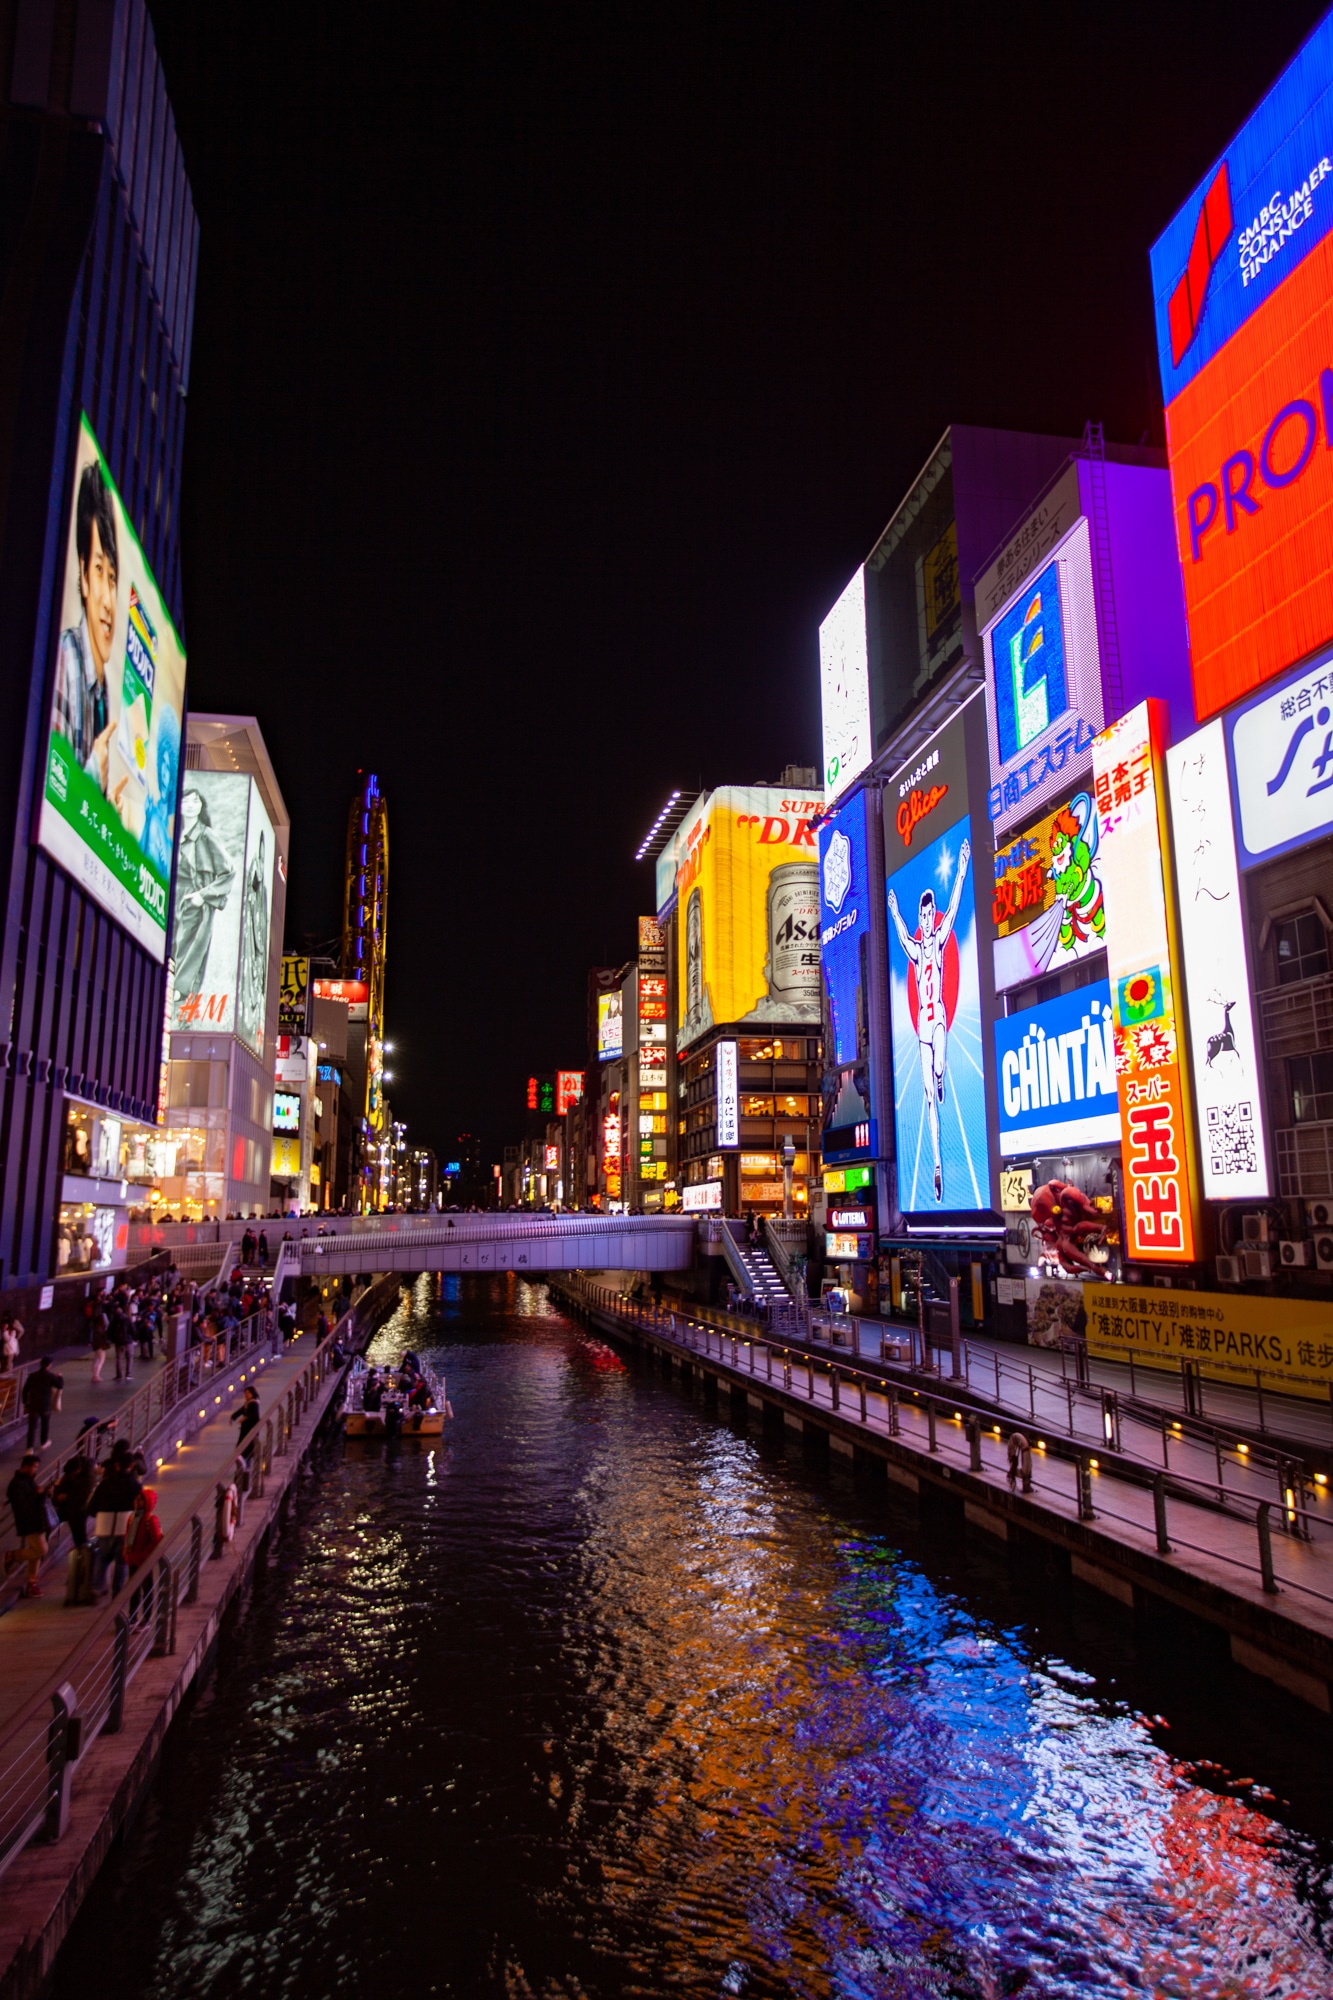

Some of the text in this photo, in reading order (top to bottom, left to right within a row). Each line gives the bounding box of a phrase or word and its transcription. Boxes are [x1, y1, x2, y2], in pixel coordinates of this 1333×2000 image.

[1238, 191, 1281, 253] SMBC
[1240, 157, 1332, 269] CONSUMER
[1242, 196, 1314, 288] FINANCE
[1280, 672, 1333, 721] 総合不
[987, 718, 1096, 822] 日商エステム
[1095, 752, 1149, 797] 日本一
[1096, 767, 1151, 818] 安売王
[896, 784, 949, 847] Glico
[994, 837, 1037, 878] かぜに
[139, 862, 166, 919] サロンパス
[991, 859, 1044, 925] 改源
[801, 953, 821, 966] 生
[177, 992, 229, 1024] H&M
[925, 960, 935, 1022] グリコ
[641, 1072, 664, 1082] 白木屋
[1126, 1076, 1170, 1102] スーパー
[724, 1095, 735, 1141] かに道楽
[1128, 1102, 1185, 1251] 玉出
[838, 1212, 866, 1225] LOTTERIA
[463, 1254, 528, 1264] えびす橋
